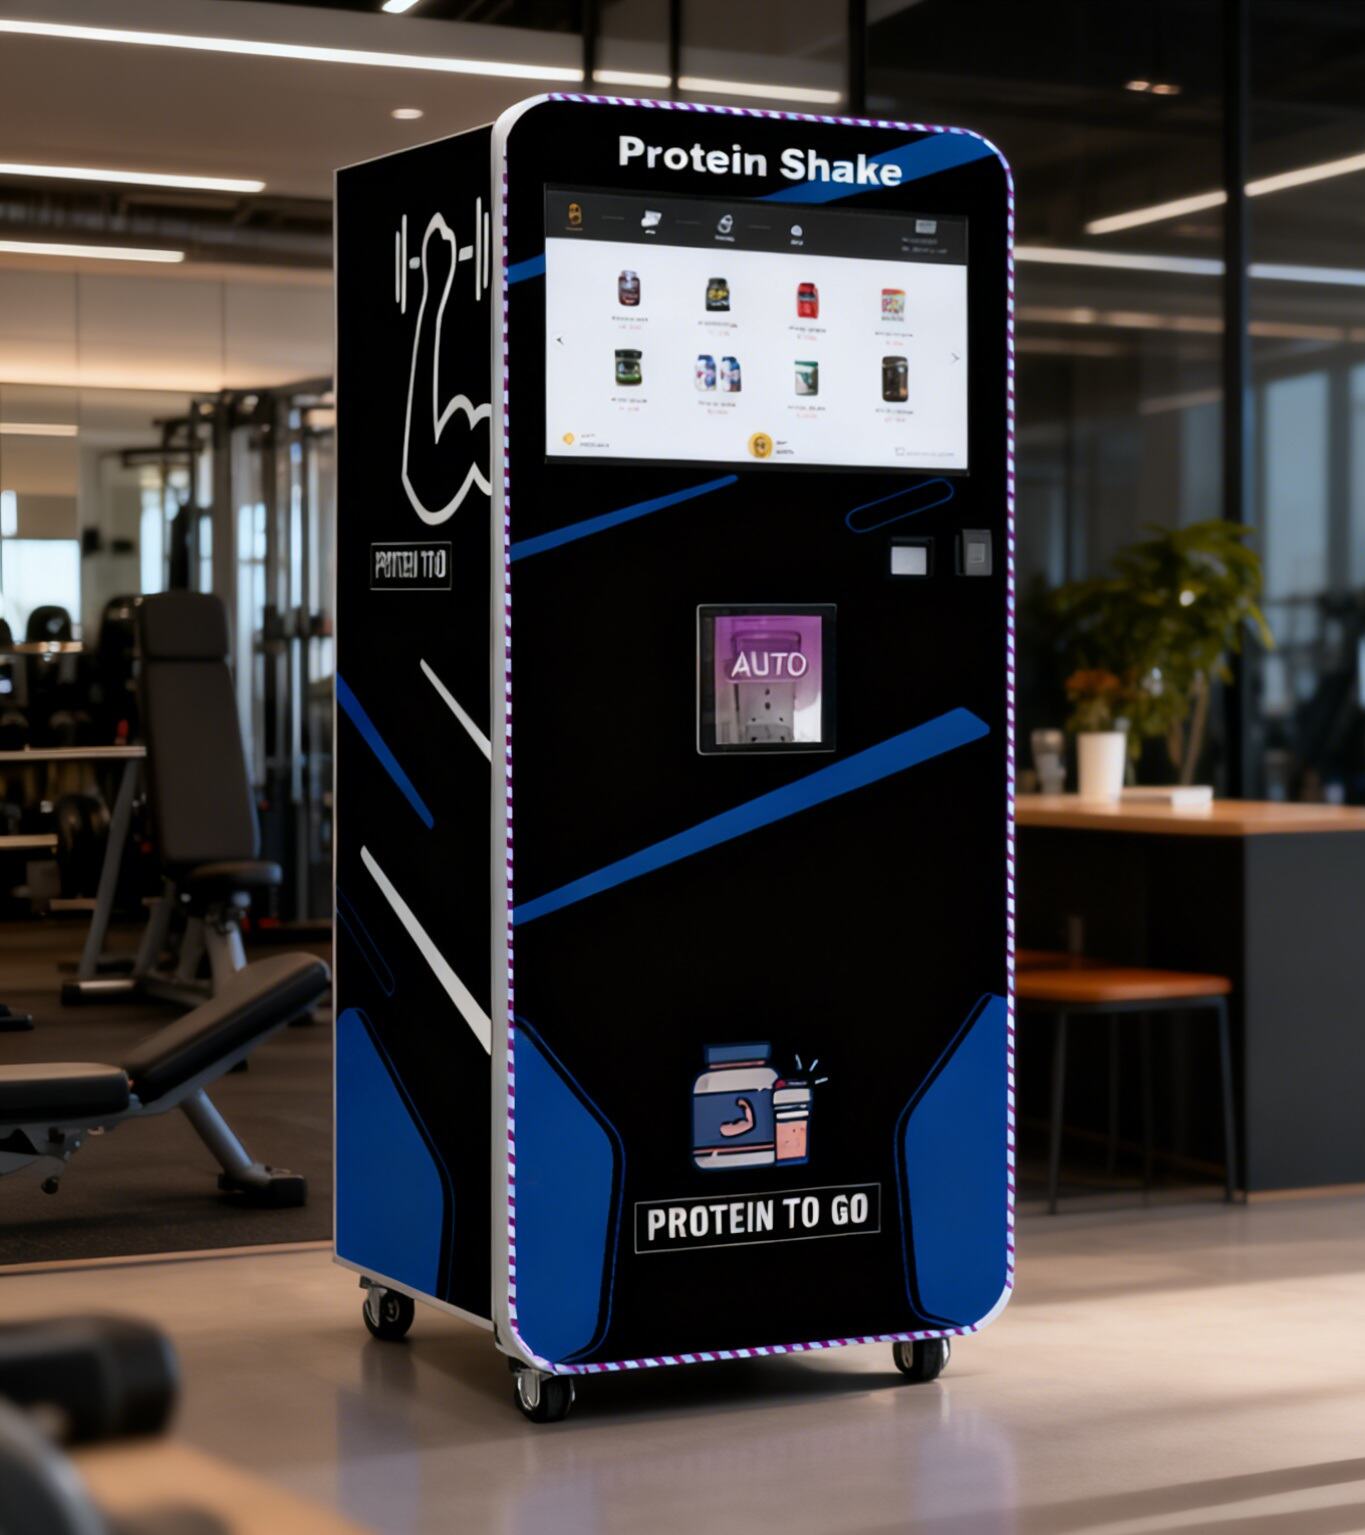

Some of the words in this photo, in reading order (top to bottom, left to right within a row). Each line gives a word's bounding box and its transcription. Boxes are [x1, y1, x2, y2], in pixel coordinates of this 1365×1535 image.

[619, 135, 767, 177] Protein
[780, 148, 903, 187] Shake
[731, 651, 807, 678] AUTO
[648, 1200, 774, 1241] PROTEIN
[782, 1196, 820, 1229] TO
[831, 1193, 868, 1226] GO
